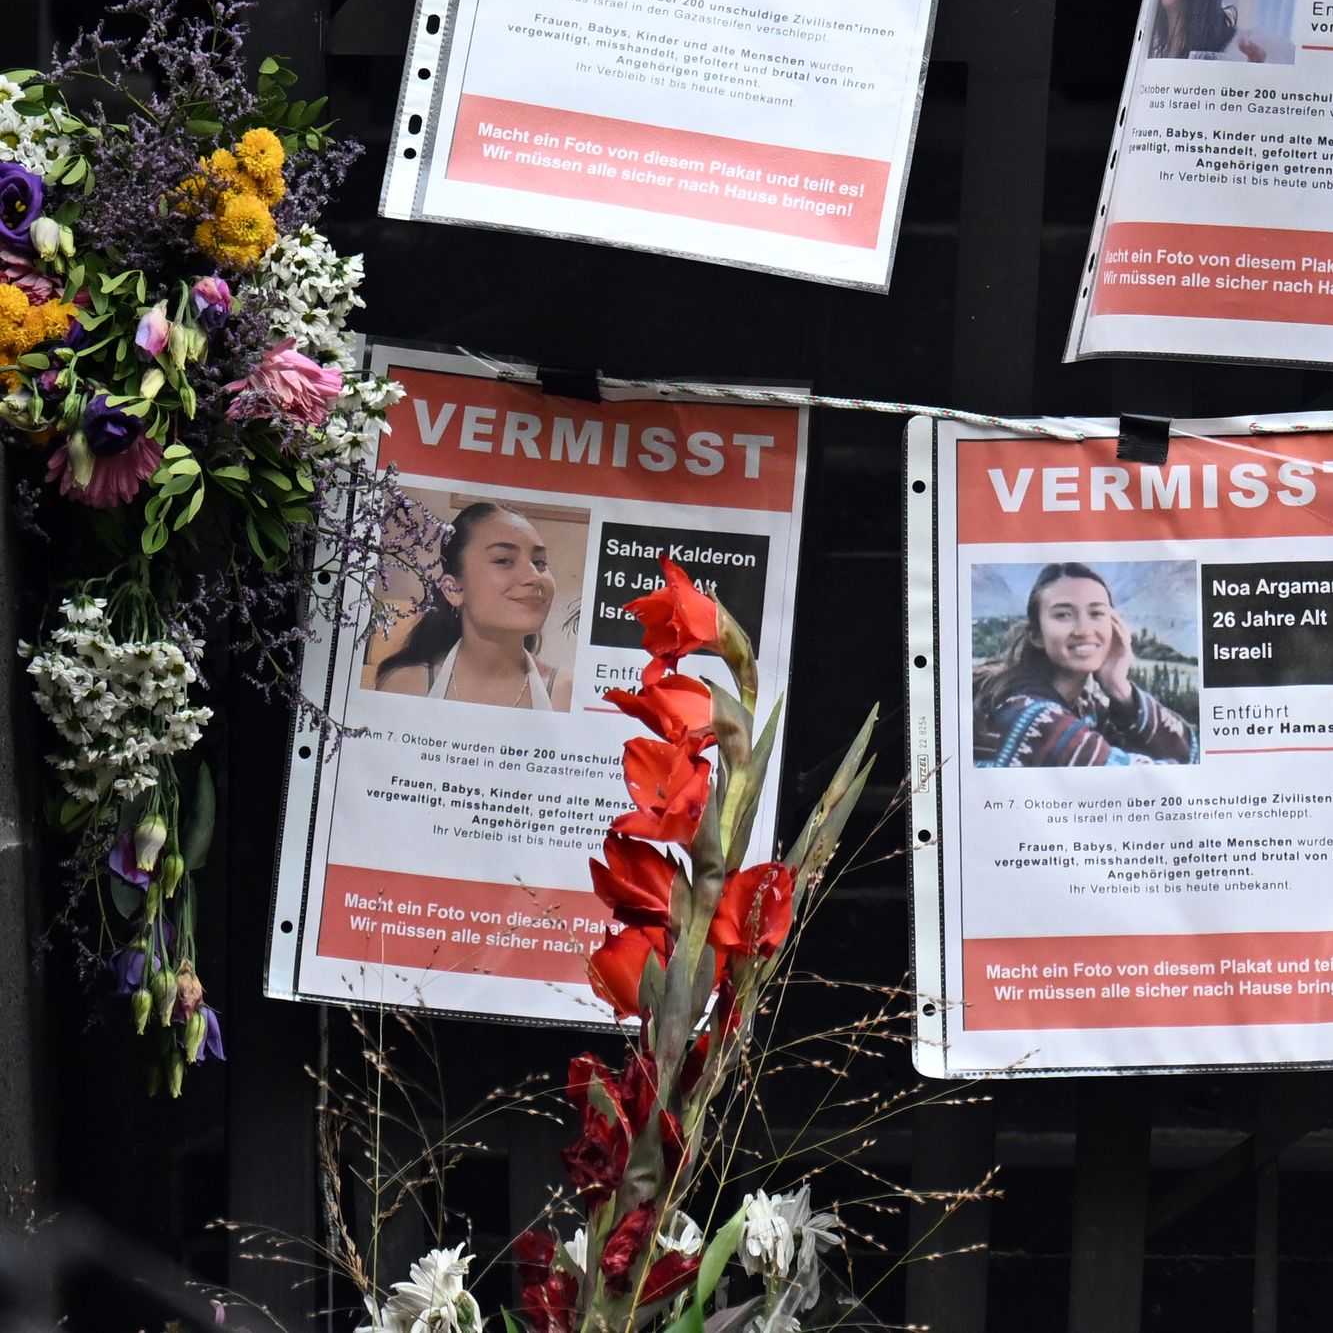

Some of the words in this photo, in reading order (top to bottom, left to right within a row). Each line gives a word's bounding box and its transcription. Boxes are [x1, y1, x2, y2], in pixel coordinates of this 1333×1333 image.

[413, 398, 774, 479] VERMISST
[606, 539, 664, 559] Sahar
[669, 544, 756, 567] Kalderon
[604, 570, 625, 588] 16
[631, 573, 665, 591] Jah
[1213, 579, 1250, 596] Noa
[600, 602, 636, 621] Isra
[1213, 611, 1236, 628] 26
[1241, 610, 1295, 627] Jahre
[1300, 609, 1327, 626] Alt
[1214, 642, 1272, 660] Israeli
[984, 800, 1003, 810] Am
[1024, 800, 1073, 809] Oktober
[1078, 799, 1121, 808] wurden
[1127, 797, 1156, 807] über
[1161, 796, 1182, 807] 200
[1188, 795, 1267, 806] unschuldige
